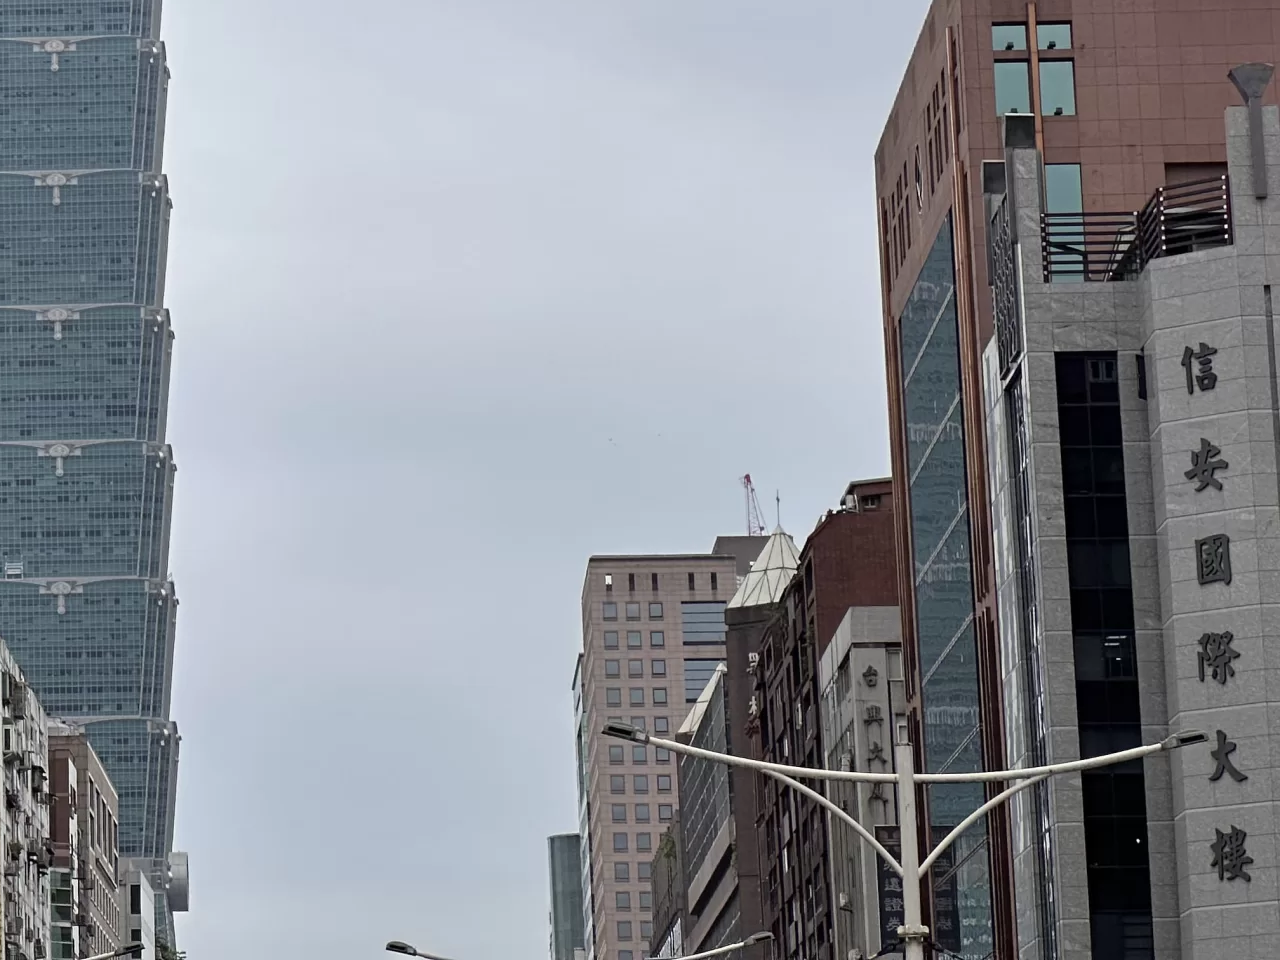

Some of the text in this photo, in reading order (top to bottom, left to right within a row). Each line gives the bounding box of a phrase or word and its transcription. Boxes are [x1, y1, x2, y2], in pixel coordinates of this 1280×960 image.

[1180, 342, 1254, 884] 信安國際大樓
